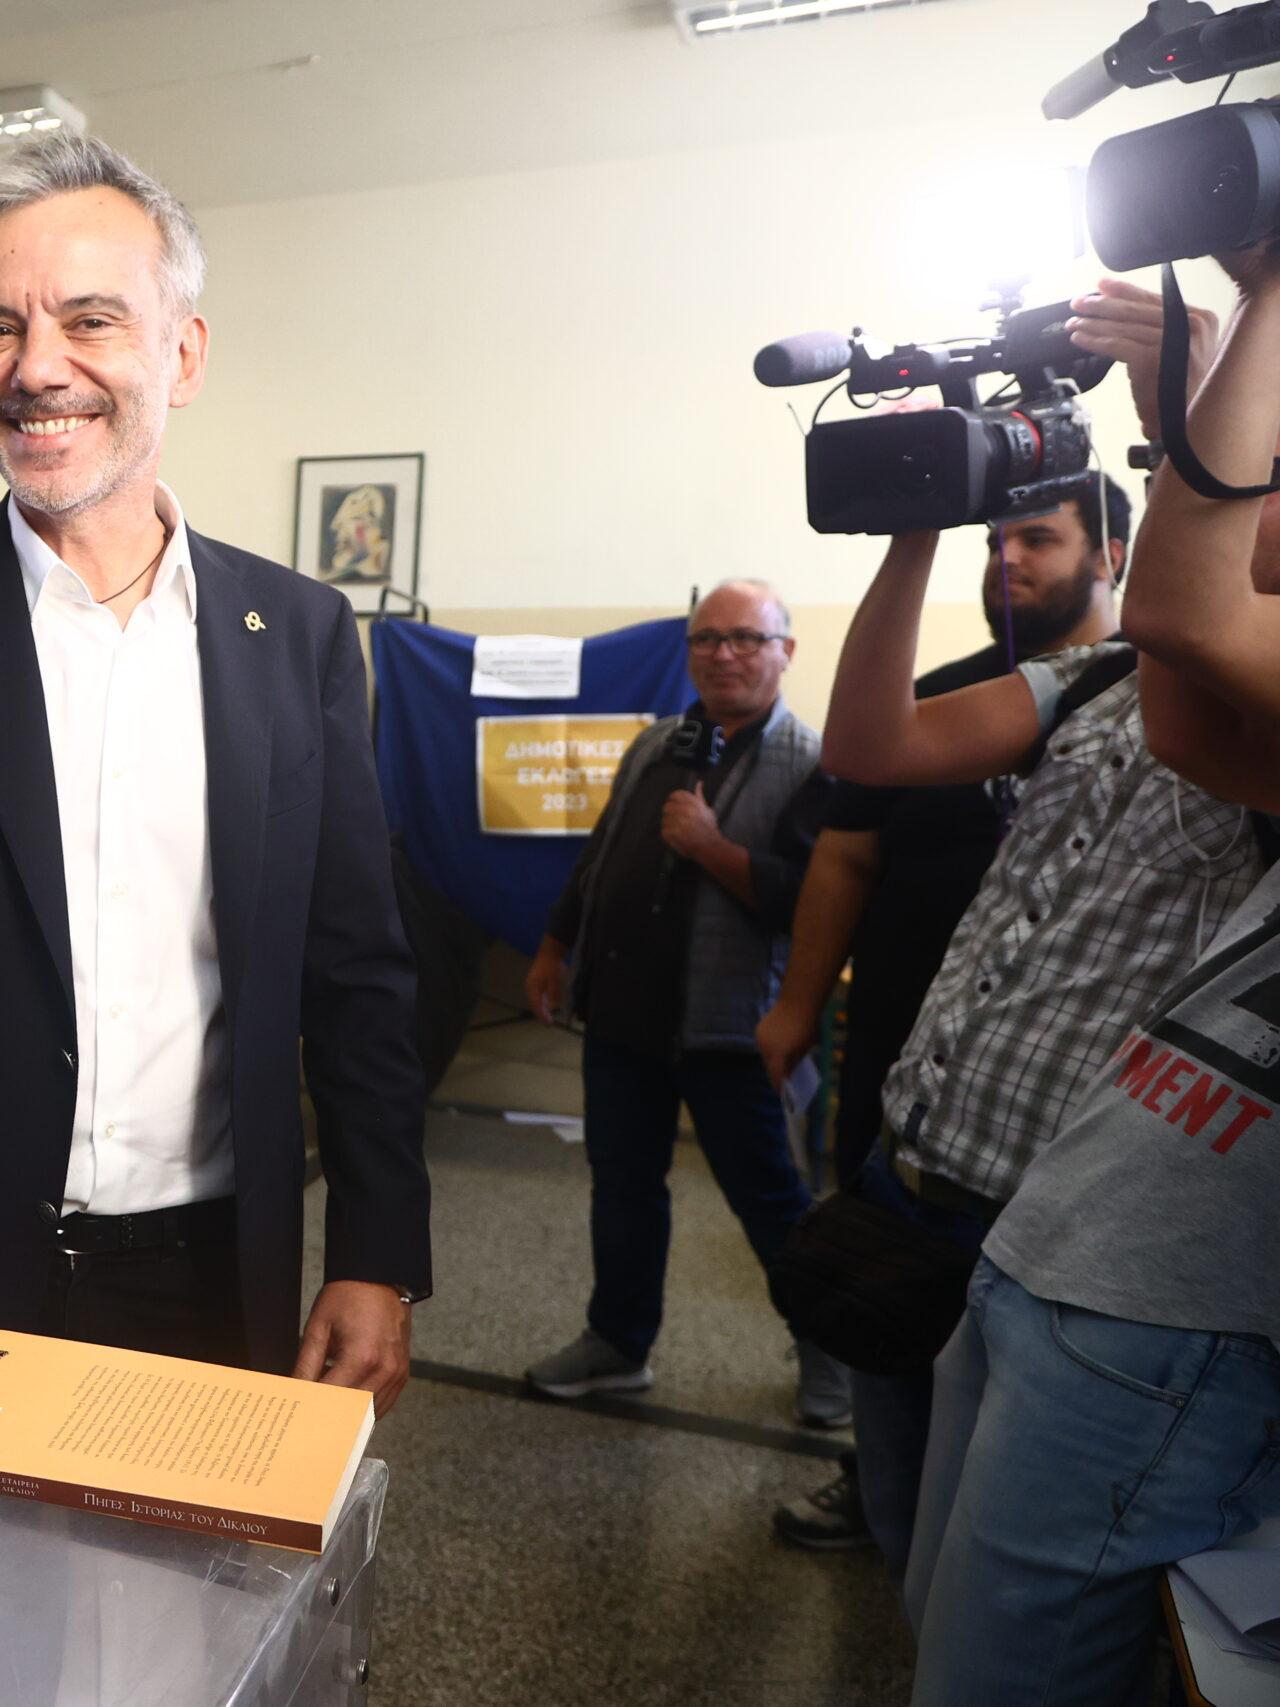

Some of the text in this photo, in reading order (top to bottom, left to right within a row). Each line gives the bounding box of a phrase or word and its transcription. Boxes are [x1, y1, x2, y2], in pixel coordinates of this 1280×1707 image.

[542, 794, 588, 812] 2023
[1114, 1034, 1274, 1156] MENT
[1, 1477, 40, 1489] ΕΤΑΙΡΕΙΑ
[2, 1486, 36, 1497] ΔΙΚΑΙΟΥ
[131, 1501, 186, 1522] ΙΣΤΟΡΙΑΣ
[190, 1513, 215, 1527] ΤΟΥ
[217, 1517, 269, 1536] ΔΙΚΑΙΟΥ
